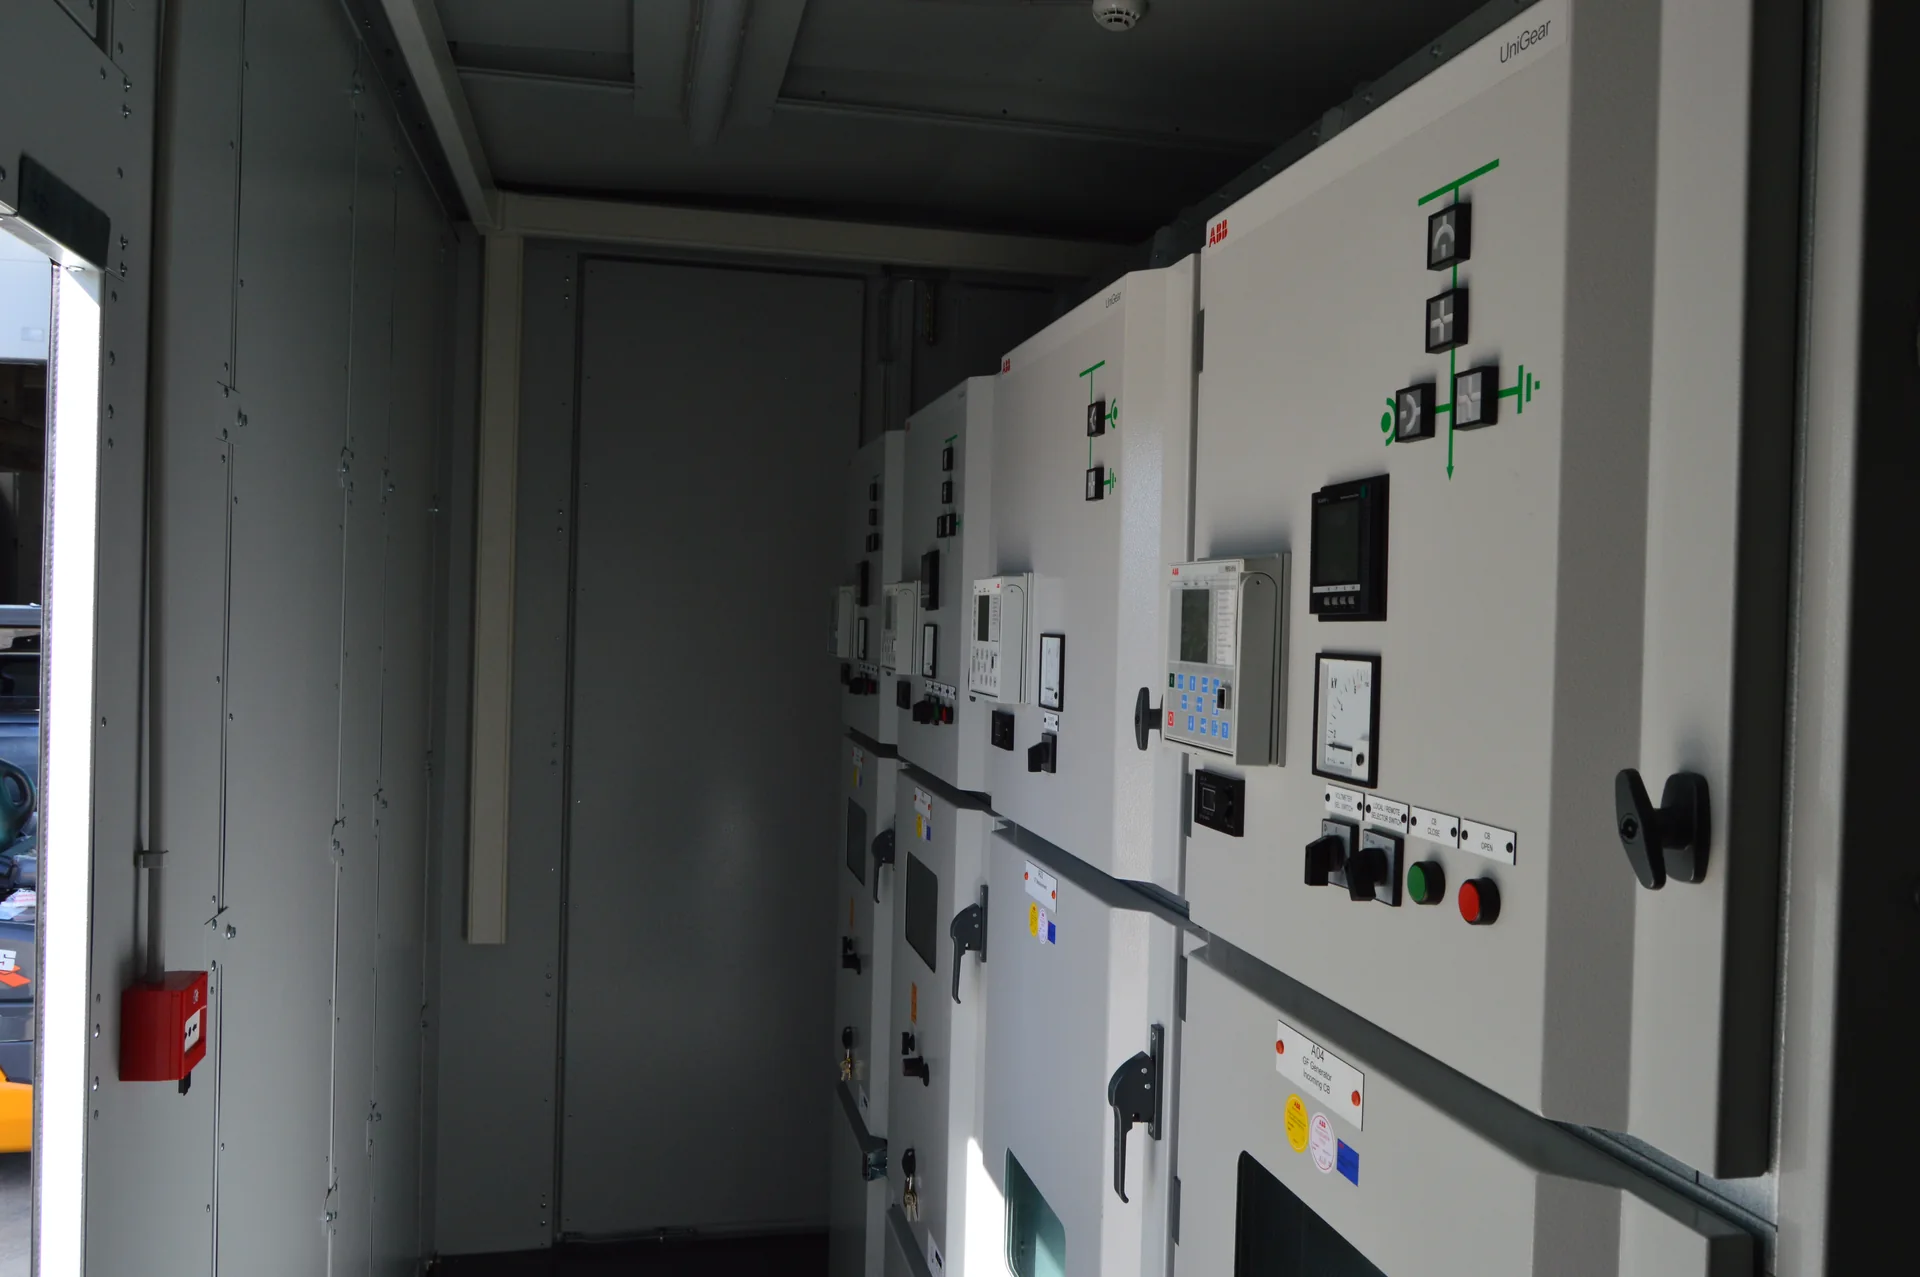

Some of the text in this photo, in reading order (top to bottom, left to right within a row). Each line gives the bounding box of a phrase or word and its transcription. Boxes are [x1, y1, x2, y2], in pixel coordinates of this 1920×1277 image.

[1500, 20, 1551, 63] UniGear
[1209, 219, 1228, 248] ABB
[1427, 827, 1440, 838] CLOSE
[1481, 842, 1493, 852] OPEN
[1311, 1044, 1325, 1063] A04
[1303, 1068, 1331, 1095] Incoming CB
[1310, 1061, 1332, 1082] Generator
